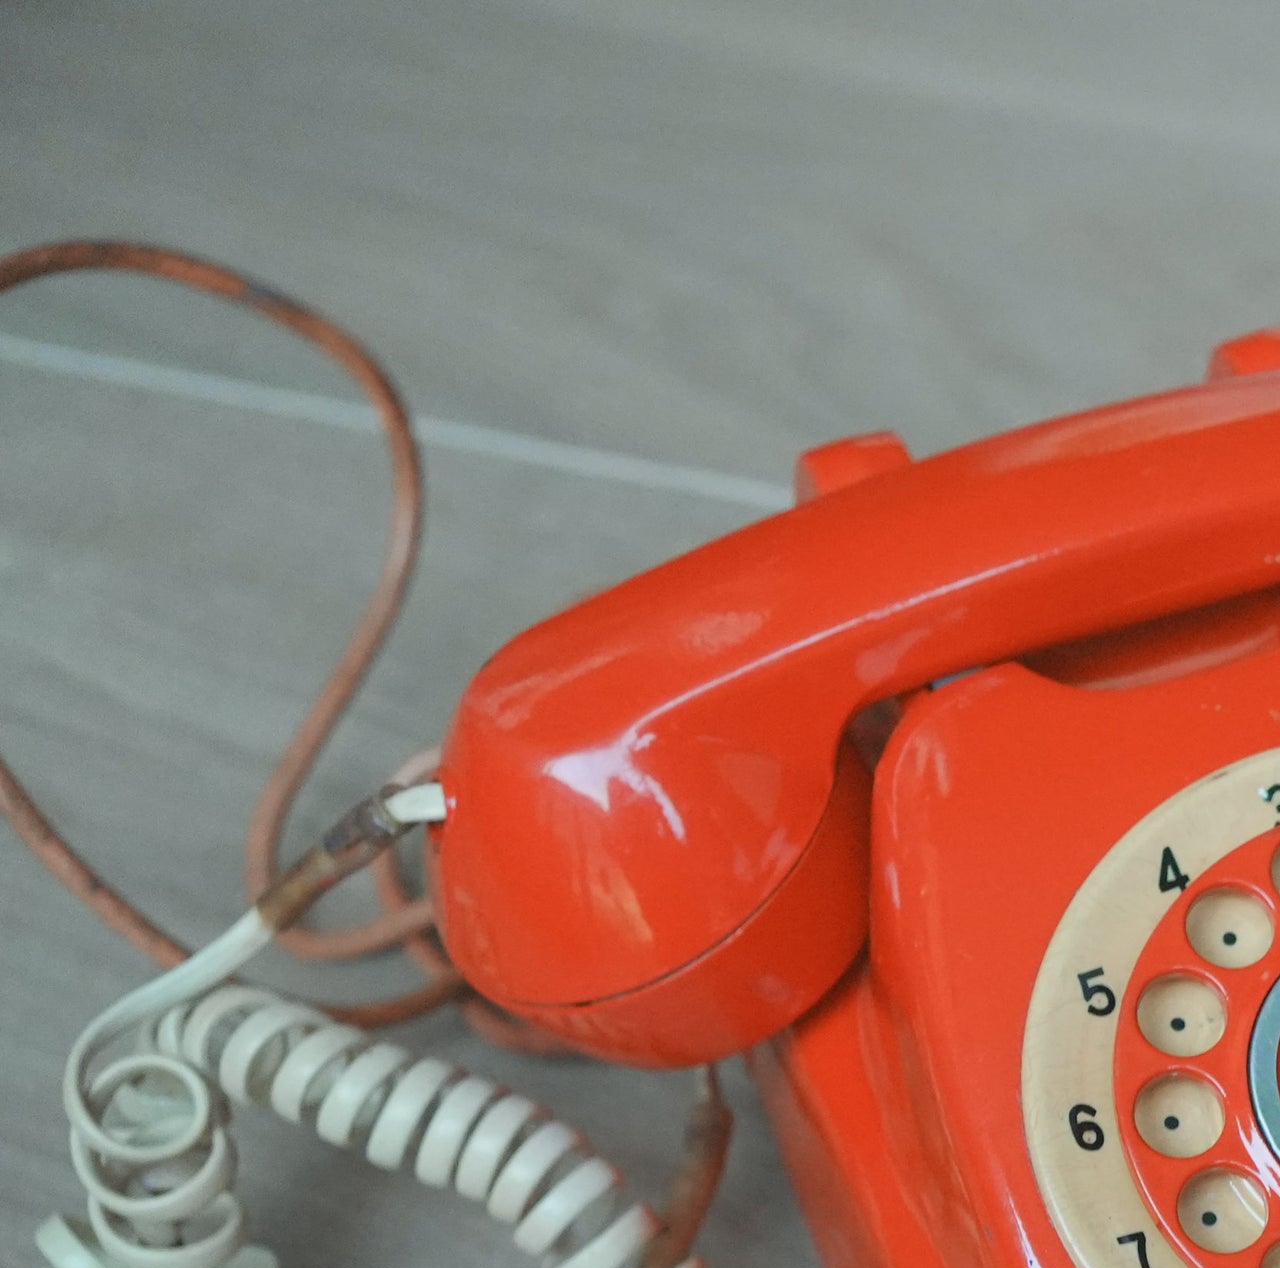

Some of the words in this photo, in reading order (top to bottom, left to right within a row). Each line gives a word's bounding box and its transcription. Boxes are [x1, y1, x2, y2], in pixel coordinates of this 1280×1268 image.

[1158, 846, 1191, 894] 4
[1077, 967, 1117, 1017] 5
[1068, 1103, 1105, 1152] 6
